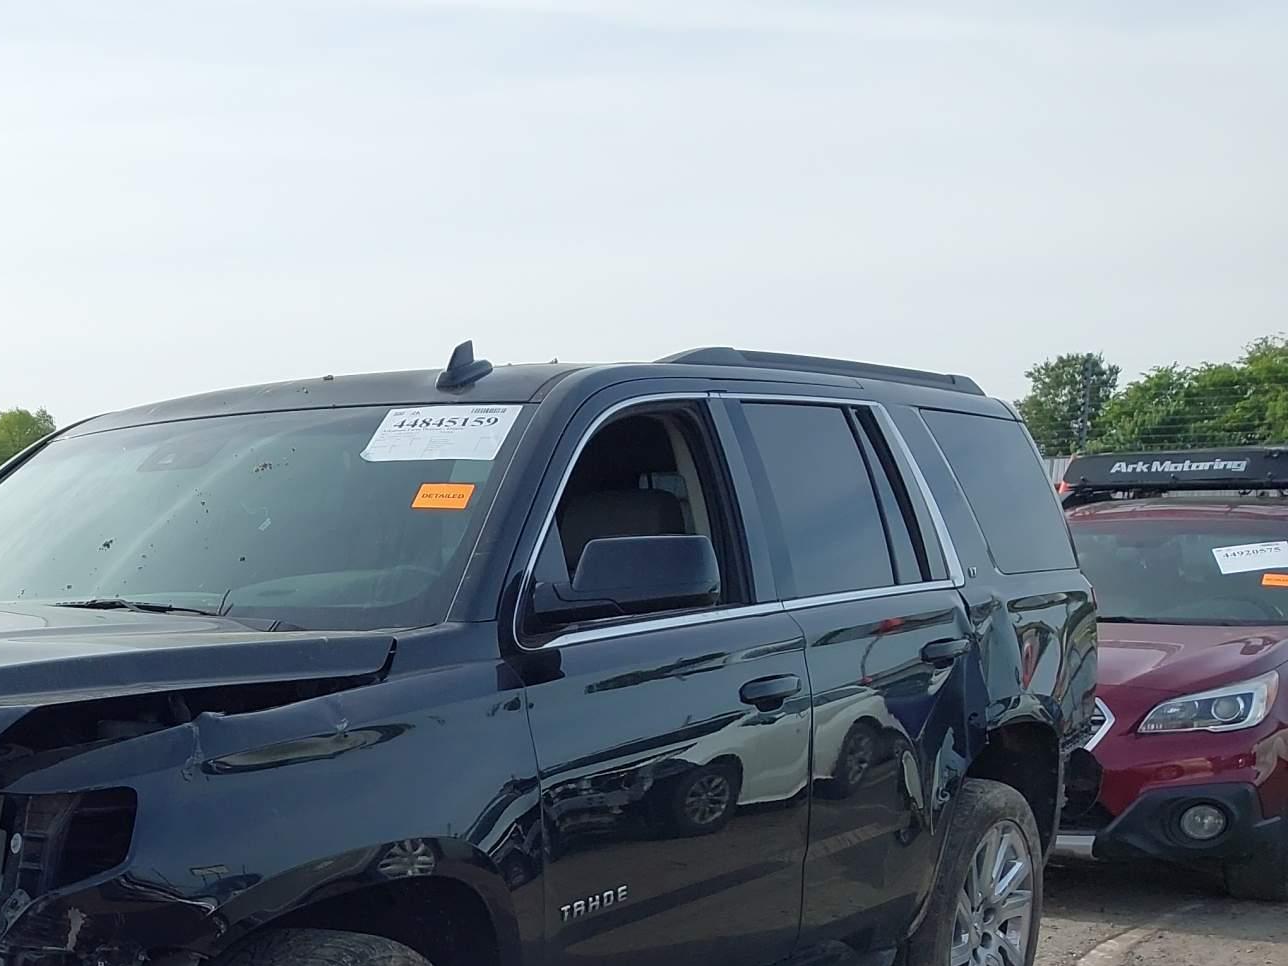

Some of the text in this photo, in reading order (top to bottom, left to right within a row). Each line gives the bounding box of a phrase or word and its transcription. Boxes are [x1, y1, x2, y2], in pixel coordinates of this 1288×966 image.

[393, 416, 499, 429] 44845159
[1110, 459, 1247, 473] Ark Motoring
[560, 885, 629, 922] TAHOE
